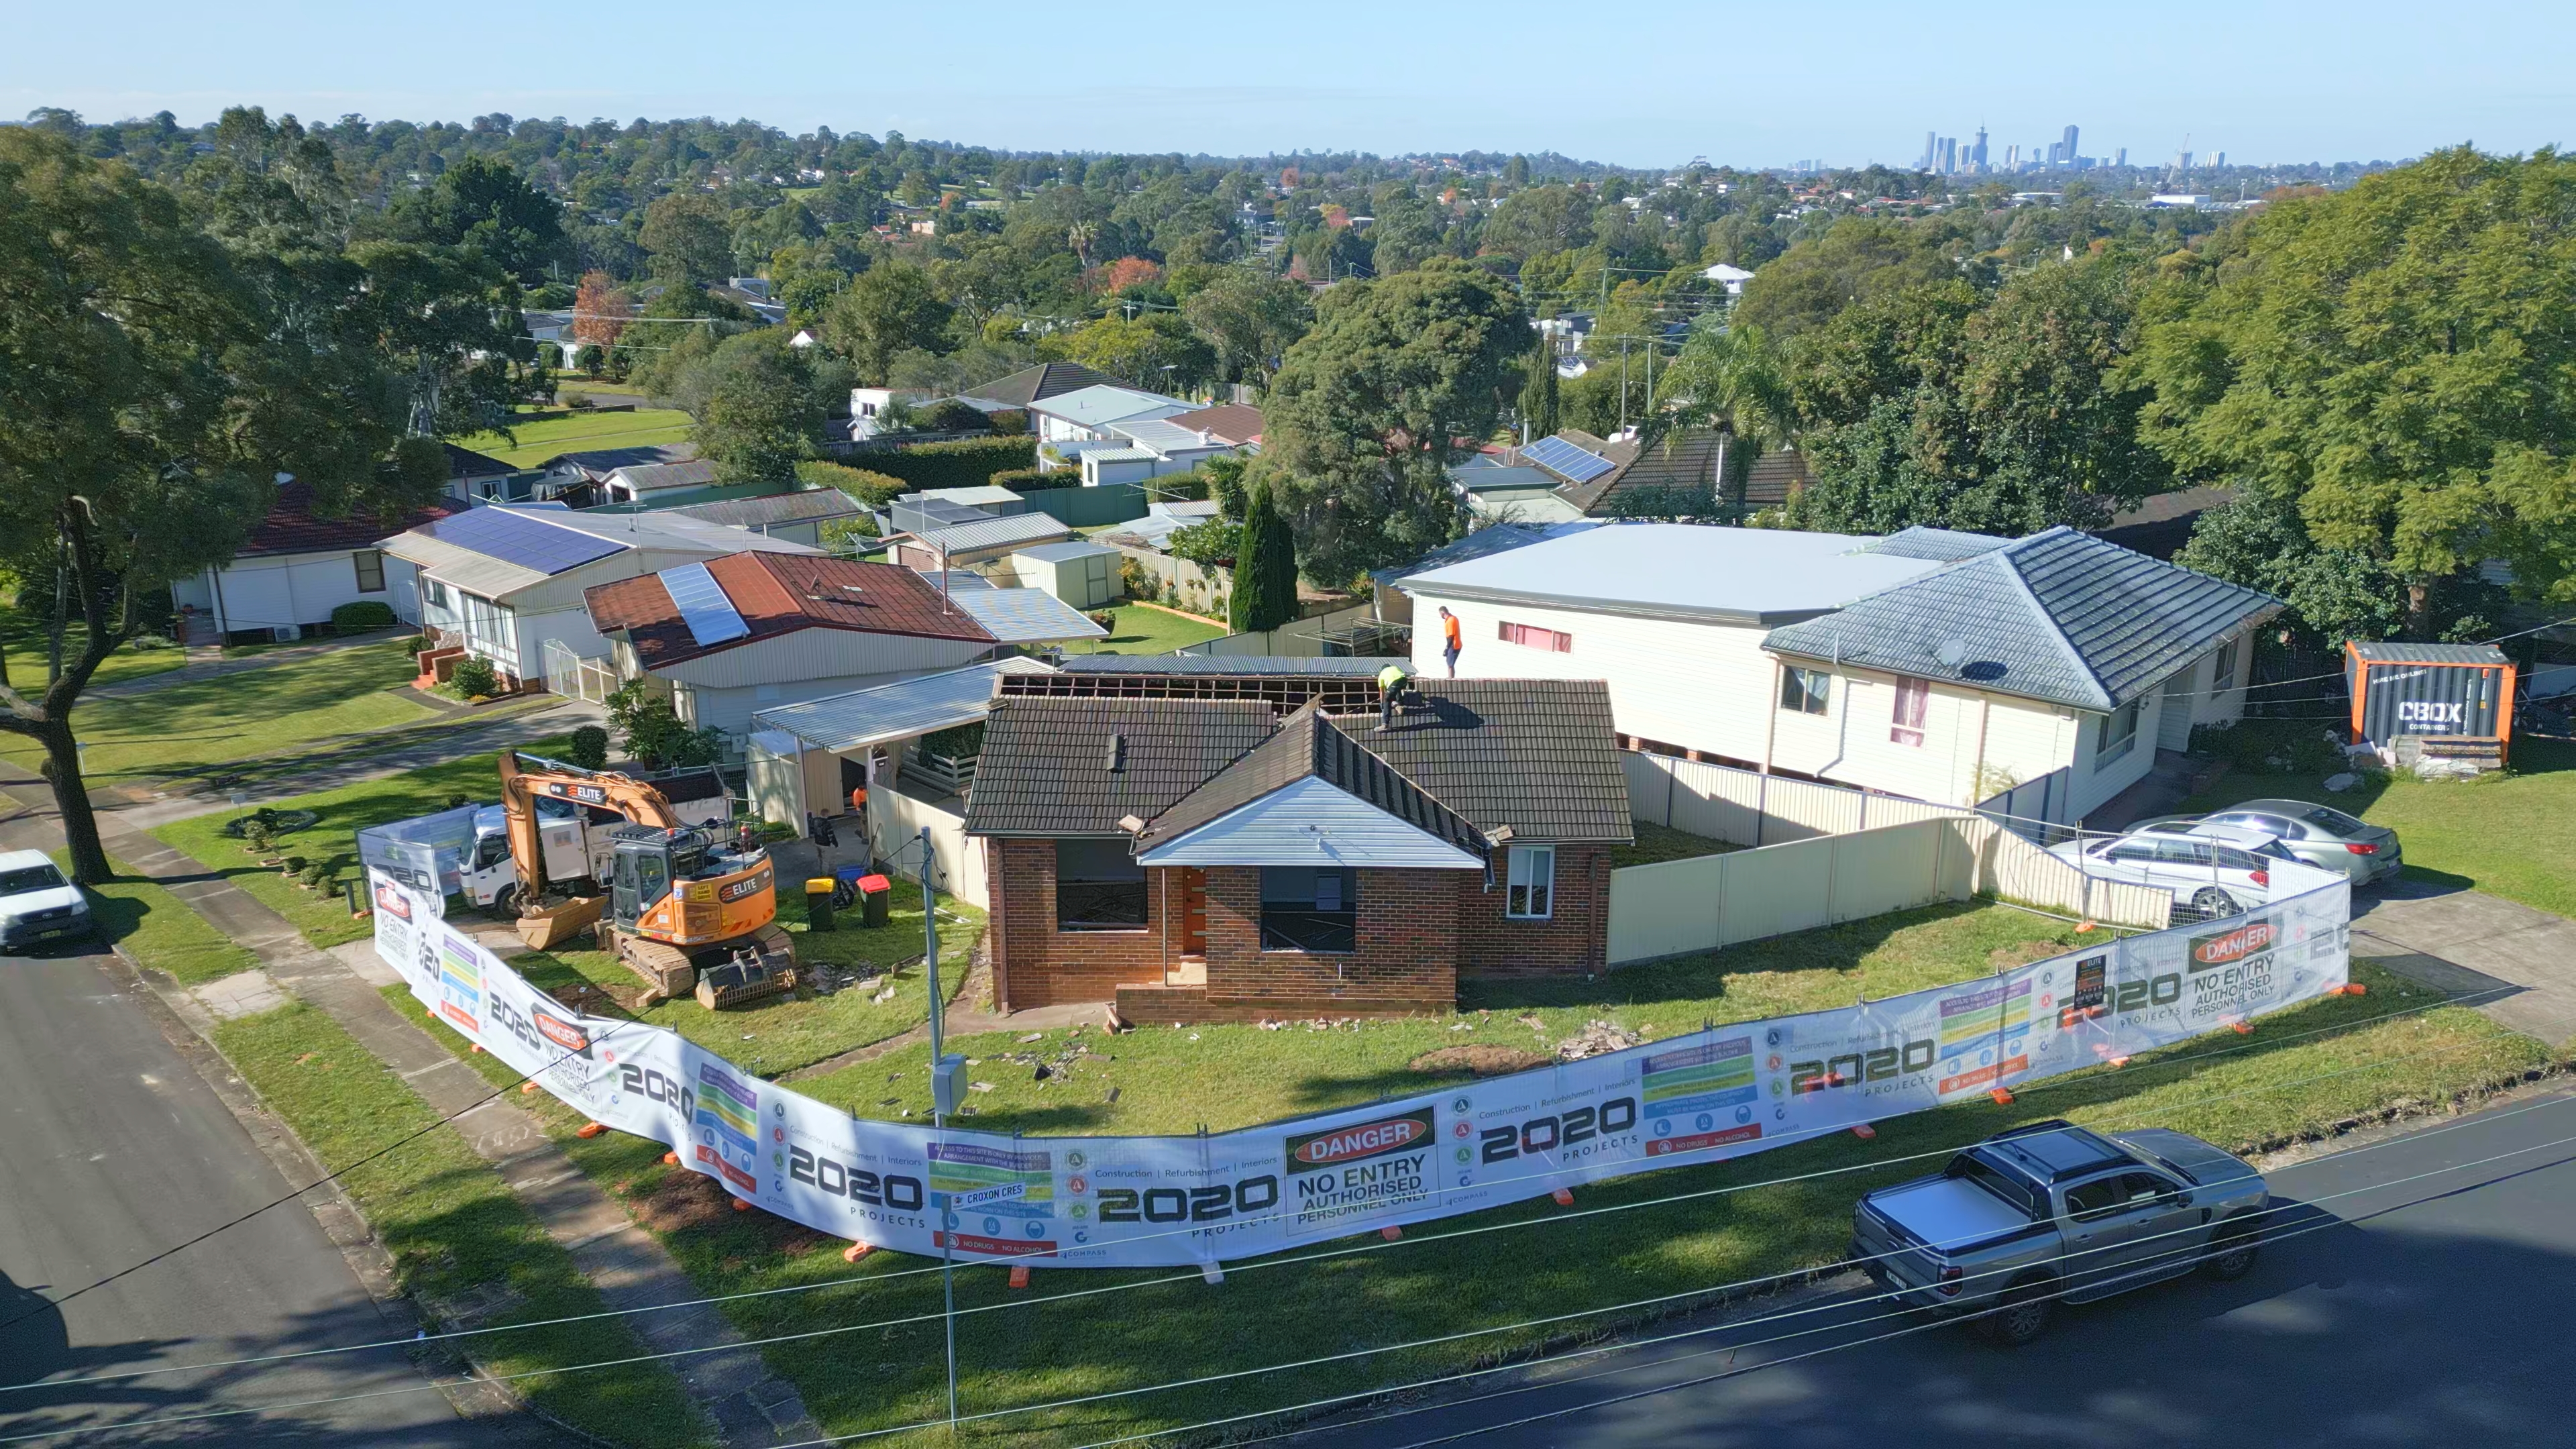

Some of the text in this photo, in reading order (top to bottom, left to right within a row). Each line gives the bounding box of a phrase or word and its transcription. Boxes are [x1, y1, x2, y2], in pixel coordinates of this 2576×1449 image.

[2398, 701, 2462, 722] CBOX
[577, 786, 602, 800] ELITE
[373, 863, 433, 892] 20
[733, 878, 757, 896] ELITE
[390, 918, 408, 941] ENTRY
[2194, 953, 2275, 994] NO ENTRY
[2196, 973, 2271, 1006] AUTHORISED
[2251, 984, 2275, 1000] ONLY
[490, 991, 541, 1051] 2020
[538, 1017, 582, 1047] DANGER
[2121, 1008, 2180, 1028] PROJECTS
[544, 1041, 558, 1061] NO
[559, 1051, 589, 1079] ENTRY
[1790, 1040, 1837, 1053] Construction
[1790, 1038, 1935, 1097] 2020
[619, 1063, 694, 1125] 2020
[1479, 1104, 1530, 1119] Construction
[1542, 1087, 1595, 1107] Refurbishment
[1605, 1078, 1636, 1091] Interiors
[1865, 1074, 1934, 1097] PROJECTS
[1311, 1123, 1410, 1160] DANGER
[1481, 1096, 1636, 1165] 2020
[1687, 1140, 1708, 1148] DRUGS
[1725, 1132, 1751, 1142] ALCOHOL
[790, 1125, 922, 1167] Construction Refurbishment Interiors
[1563, 1135, 1638, 1161] PROJECTS
[790, 1144, 923, 1212] 2020
[1095, 1157, 1277, 1178] Construction Refurbishment Interiors
[1298, 1154, 1426, 1198] NO ENTRY
[967, 1189, 1000, 1203] CROXON
[1002, 1185, 1022, 1197] CRES
[1097, 1175, 1278, 1223] 2020
[1297, 1189, 1429, 1224] PERSONNEL ONLY
[1303, 1175, 1421, 1212] AUTHORISED
[1453, 1191, 1487, 1203] COMPASS
[851, 1207, 925, 1228] PROJECTS
[1192, 1213, 1279, 1238] PROJECTS
[974, 1242, 994, 1250] DRUGS
